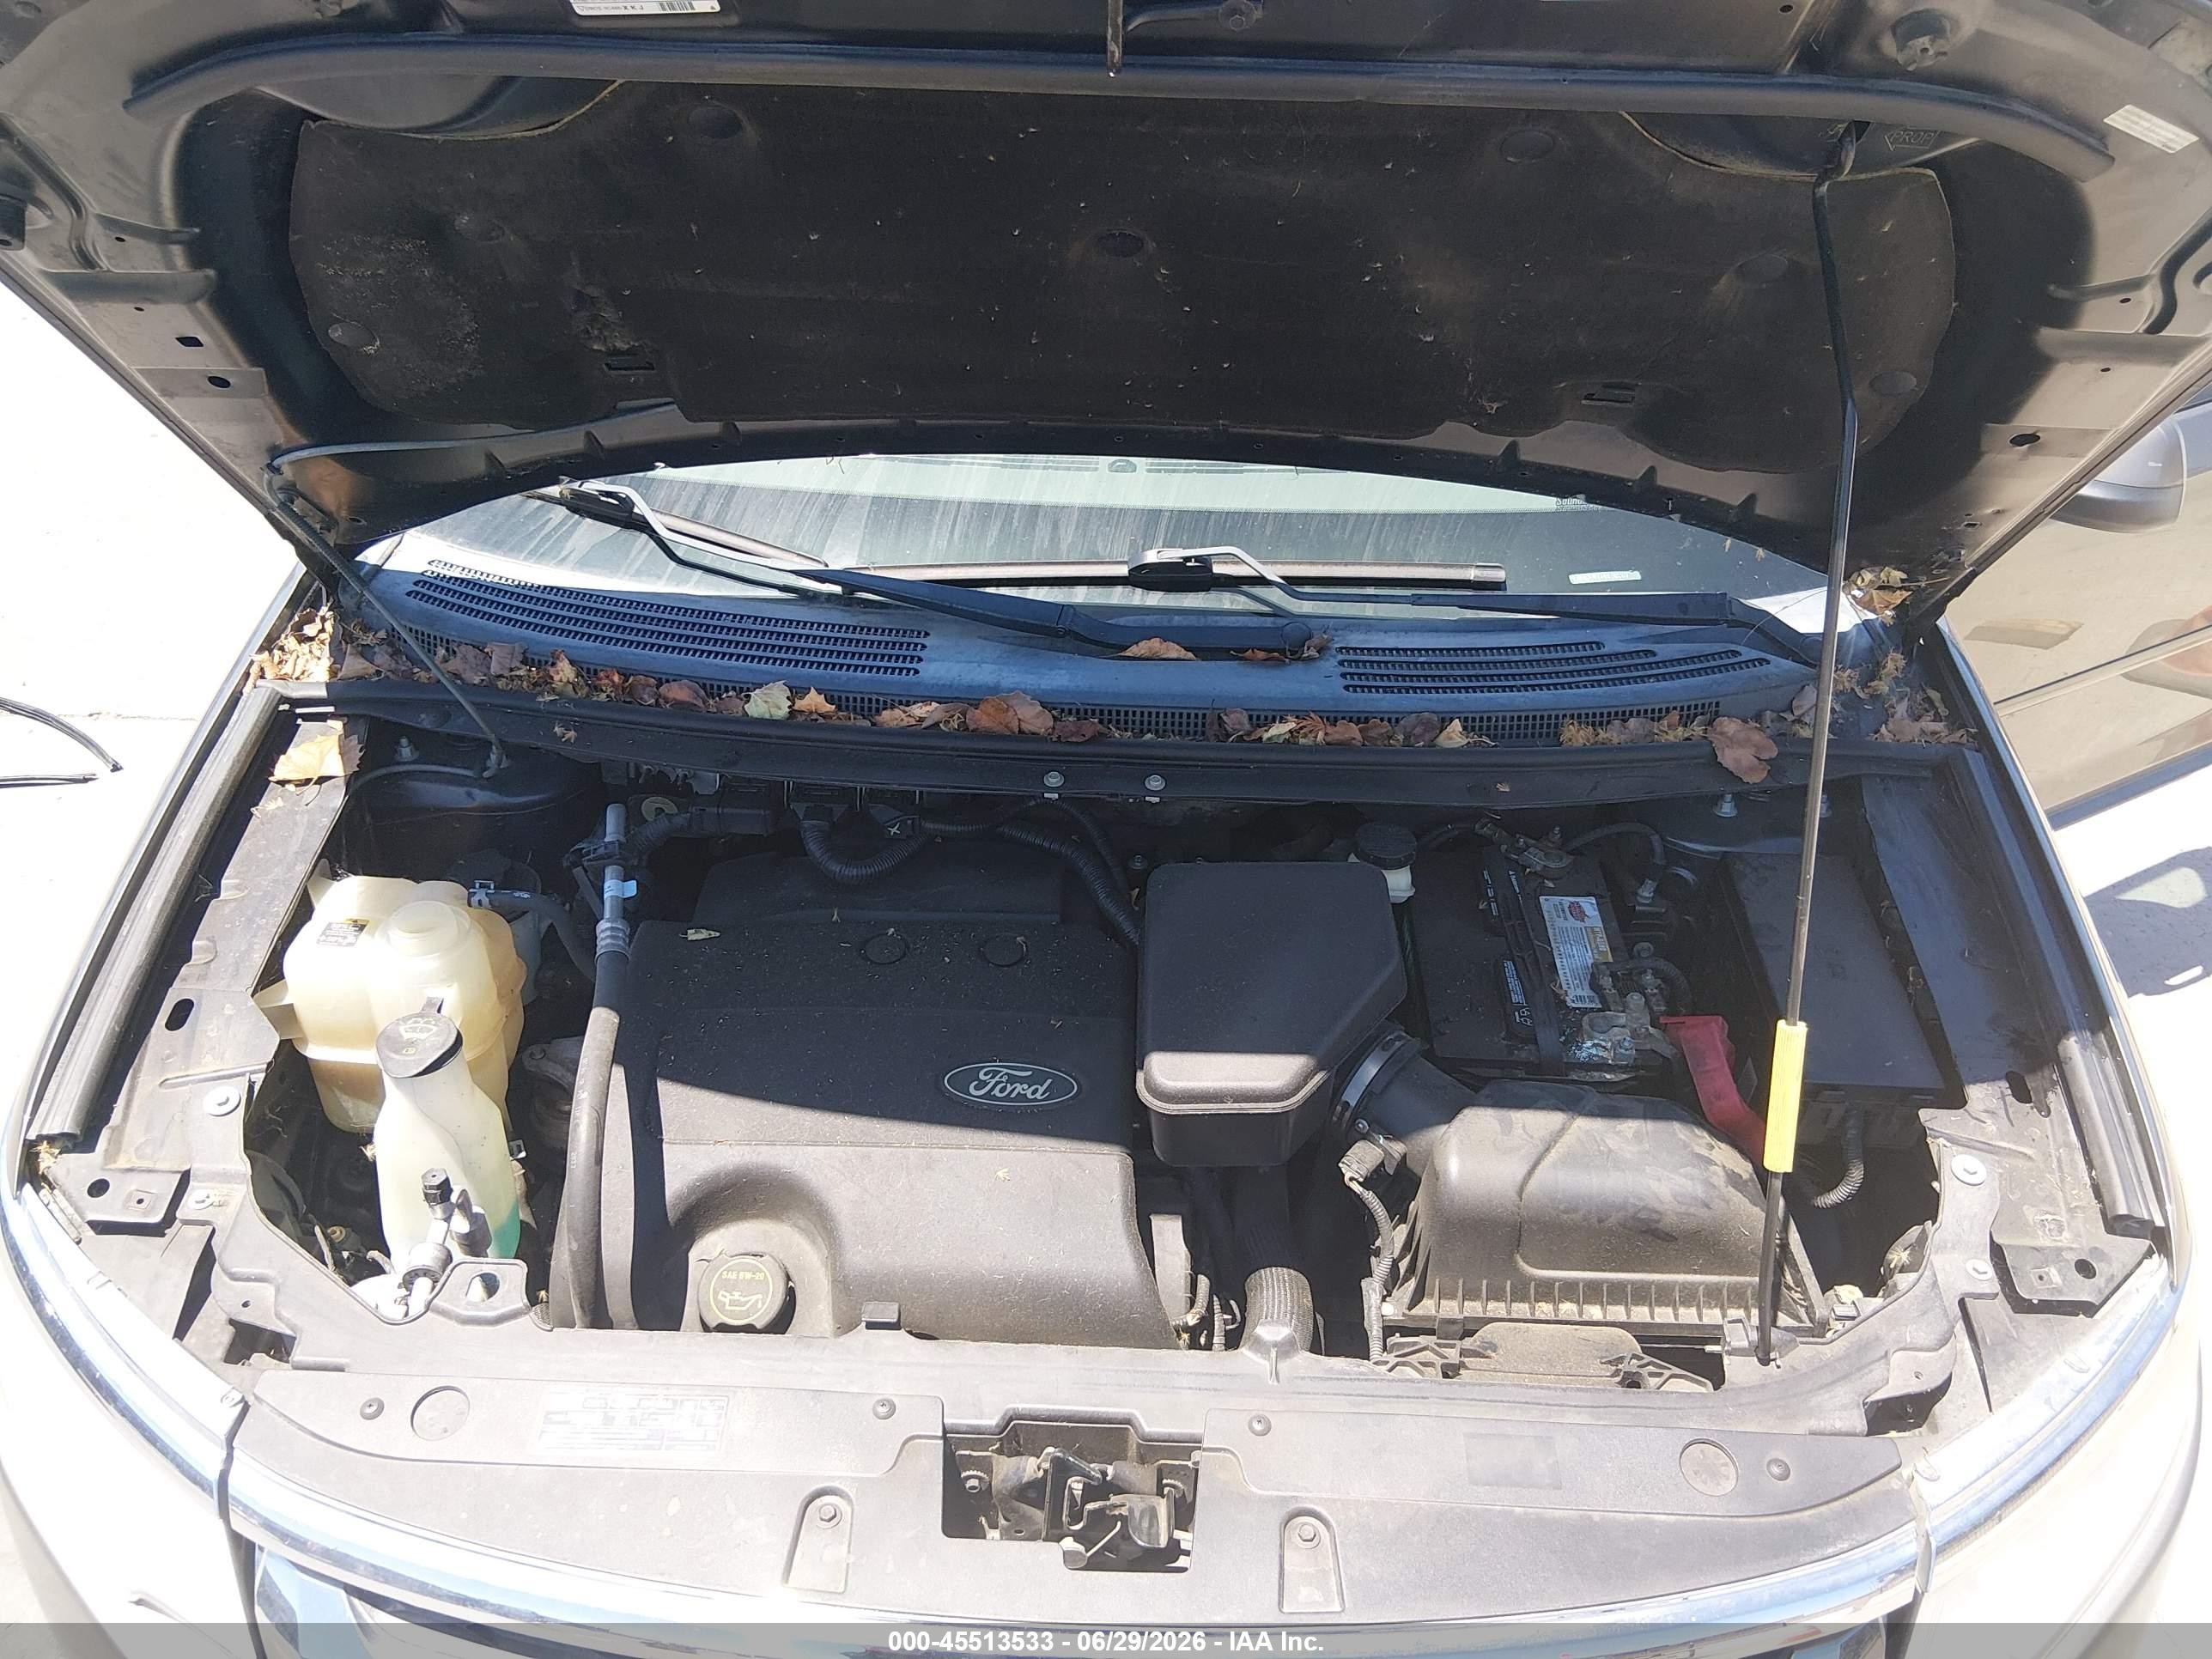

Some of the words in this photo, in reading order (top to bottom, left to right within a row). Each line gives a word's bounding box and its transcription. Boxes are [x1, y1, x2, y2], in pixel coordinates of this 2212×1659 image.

[1889, 131, 1934, 143] PROP
[969, 1066, 1053, 1100] Ford
[721, 1270, 738, 1279] SAE
